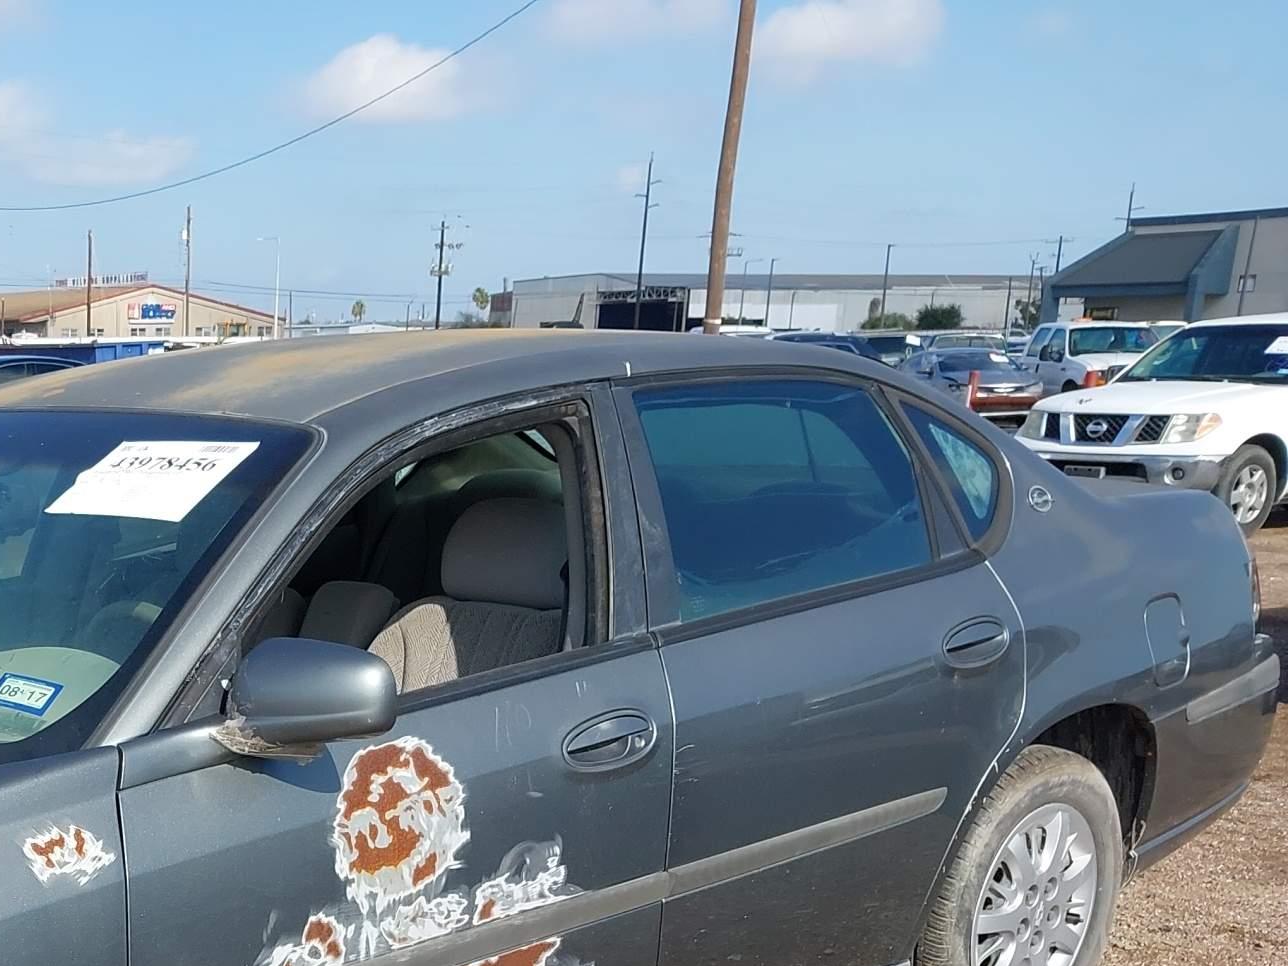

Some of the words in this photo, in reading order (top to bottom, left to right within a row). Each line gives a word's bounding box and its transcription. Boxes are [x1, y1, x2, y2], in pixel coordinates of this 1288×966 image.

[110, 456, 220, 472] 43978456
[0, 684, 21, 698] 08
[26, 690, 49, 704] 17
